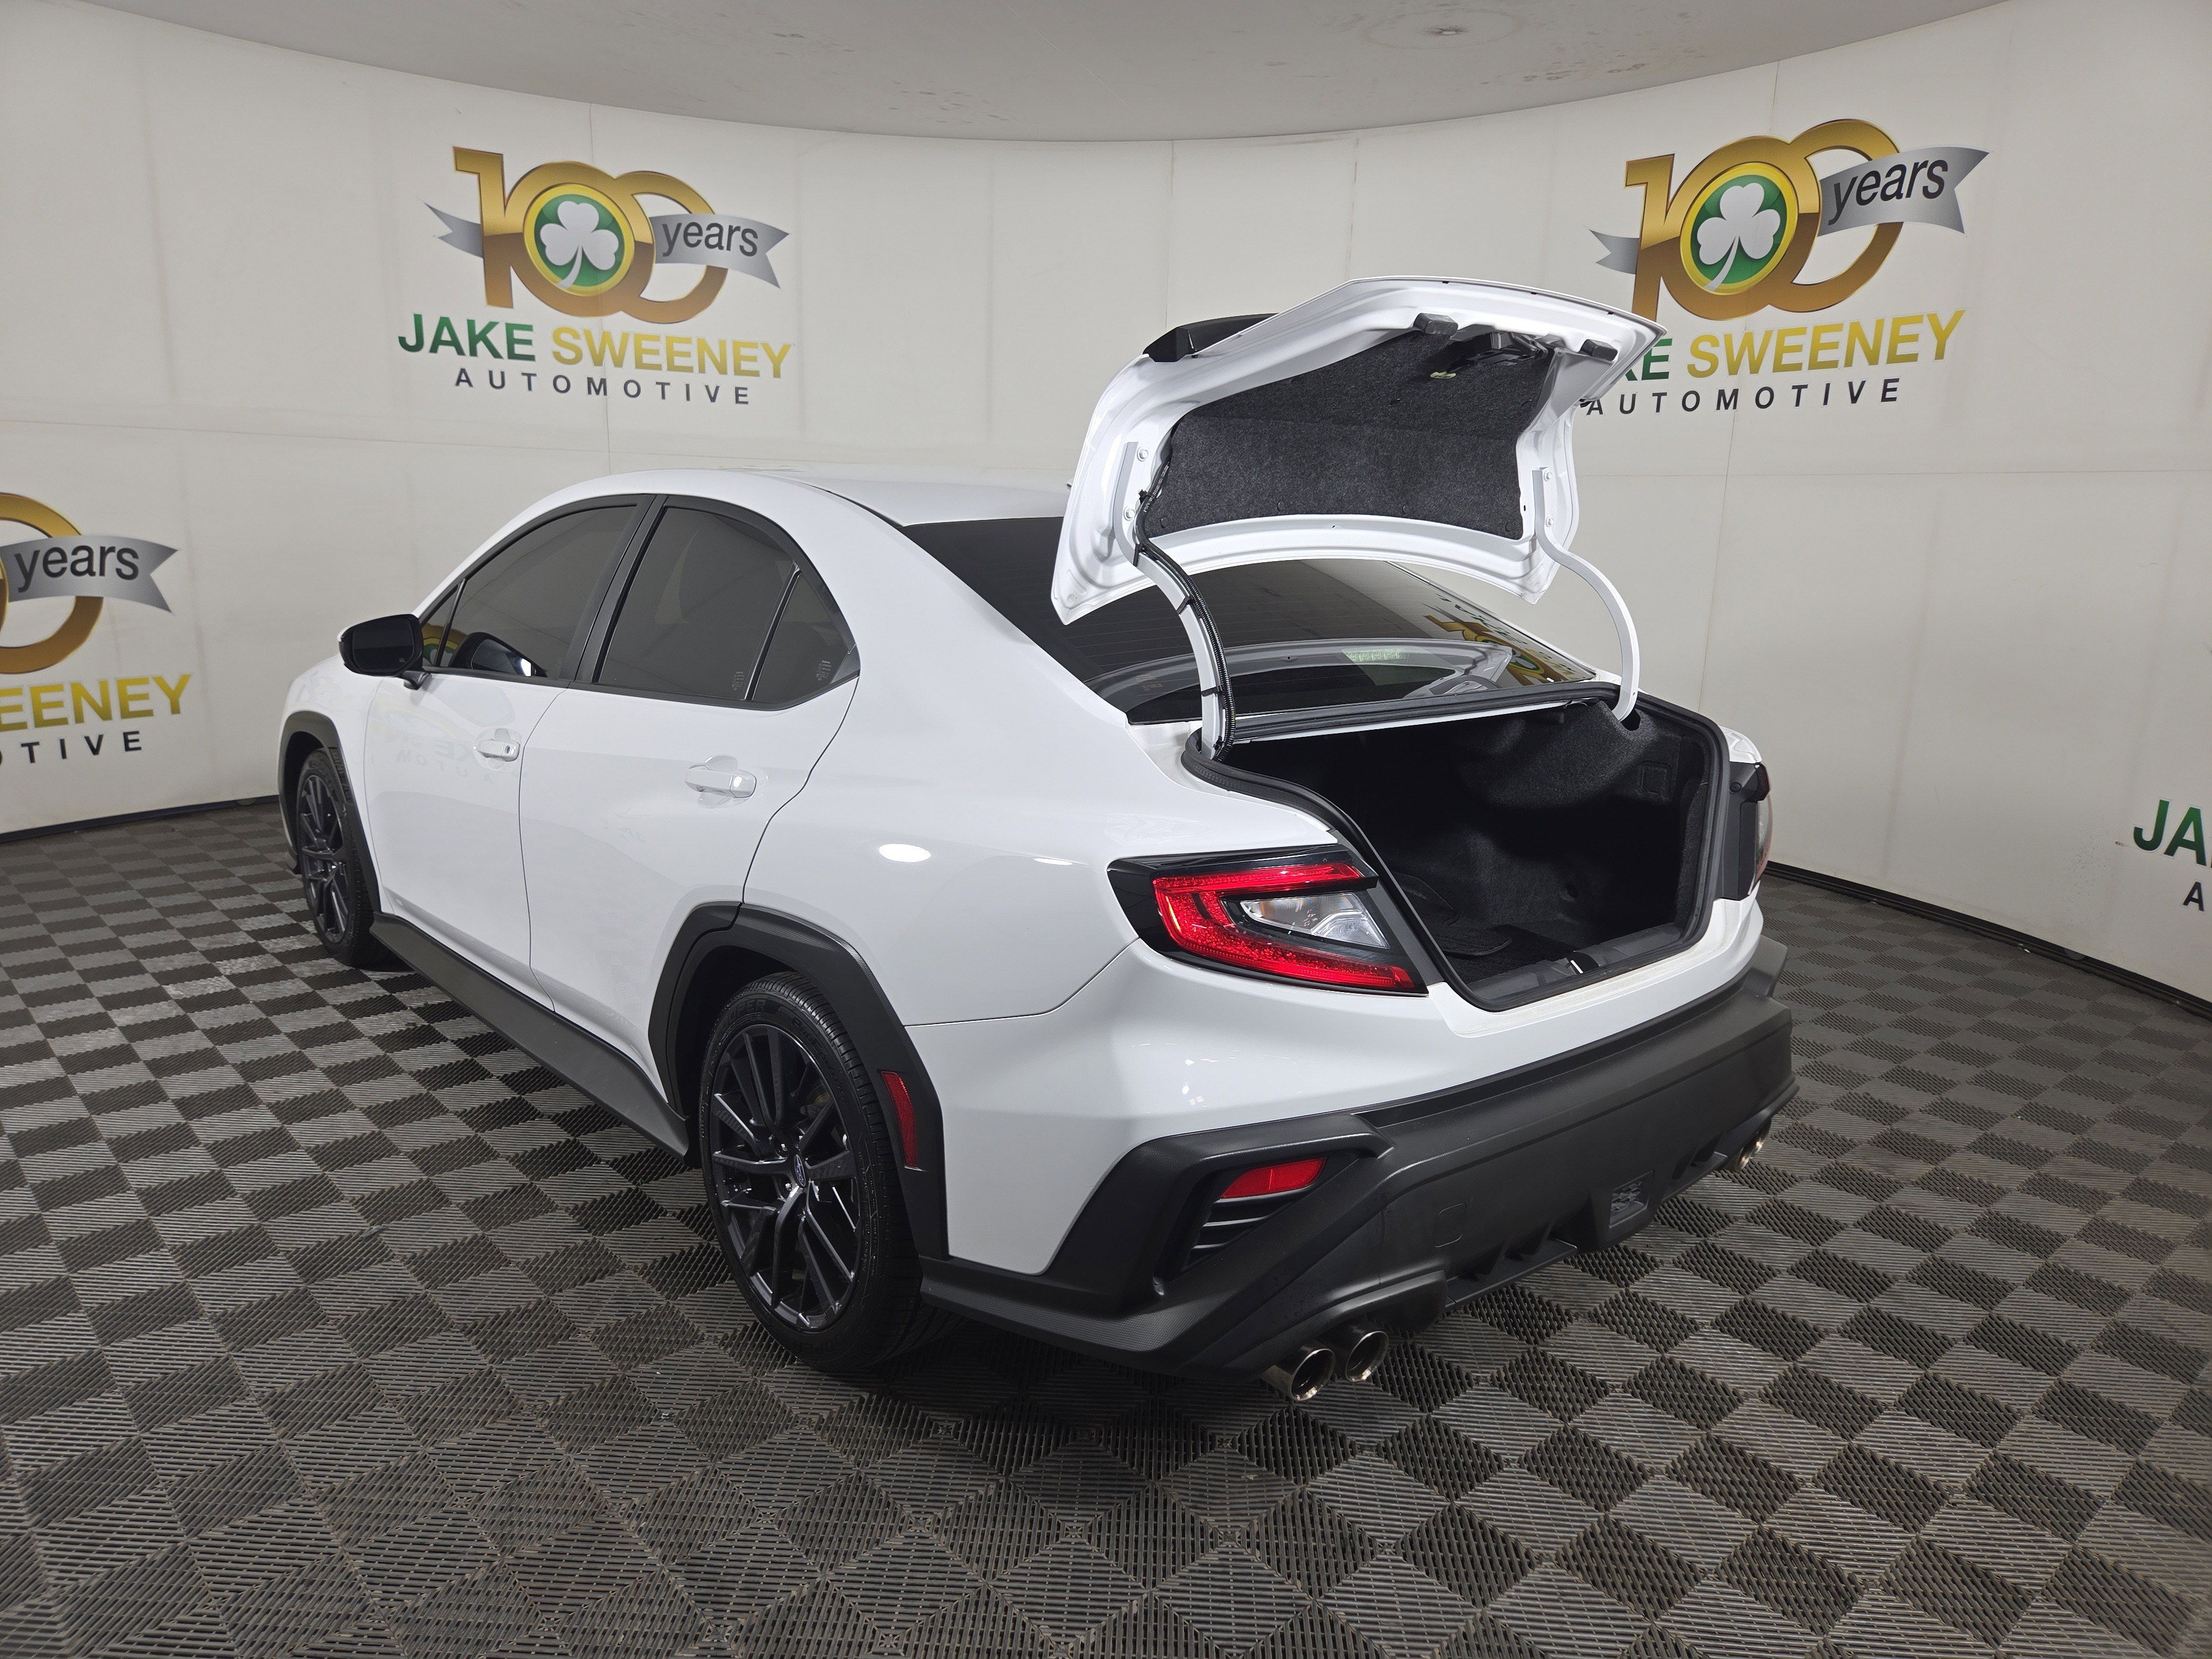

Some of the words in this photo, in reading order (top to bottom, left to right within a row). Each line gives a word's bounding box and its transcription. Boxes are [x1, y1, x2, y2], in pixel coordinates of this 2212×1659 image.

[453, 146, 730, 324] 100
[661, 221, 758, 258] years
[1624, 119, 1905, 321] 100
[1828, 159, 1948, 226] years
[398, 313, 536, 363] JAKE
[552, 326, 793, 379] SWEENEY
[1687, 310, 1966, 378] SWEENEY
[454, 368, 749, 405] AUTOMOTIVE
[1586, 378, 1900, 416] AUTOMOTIVE
[15, 544, 139, 593] years
[0, 731, 142, 765] TIVE
